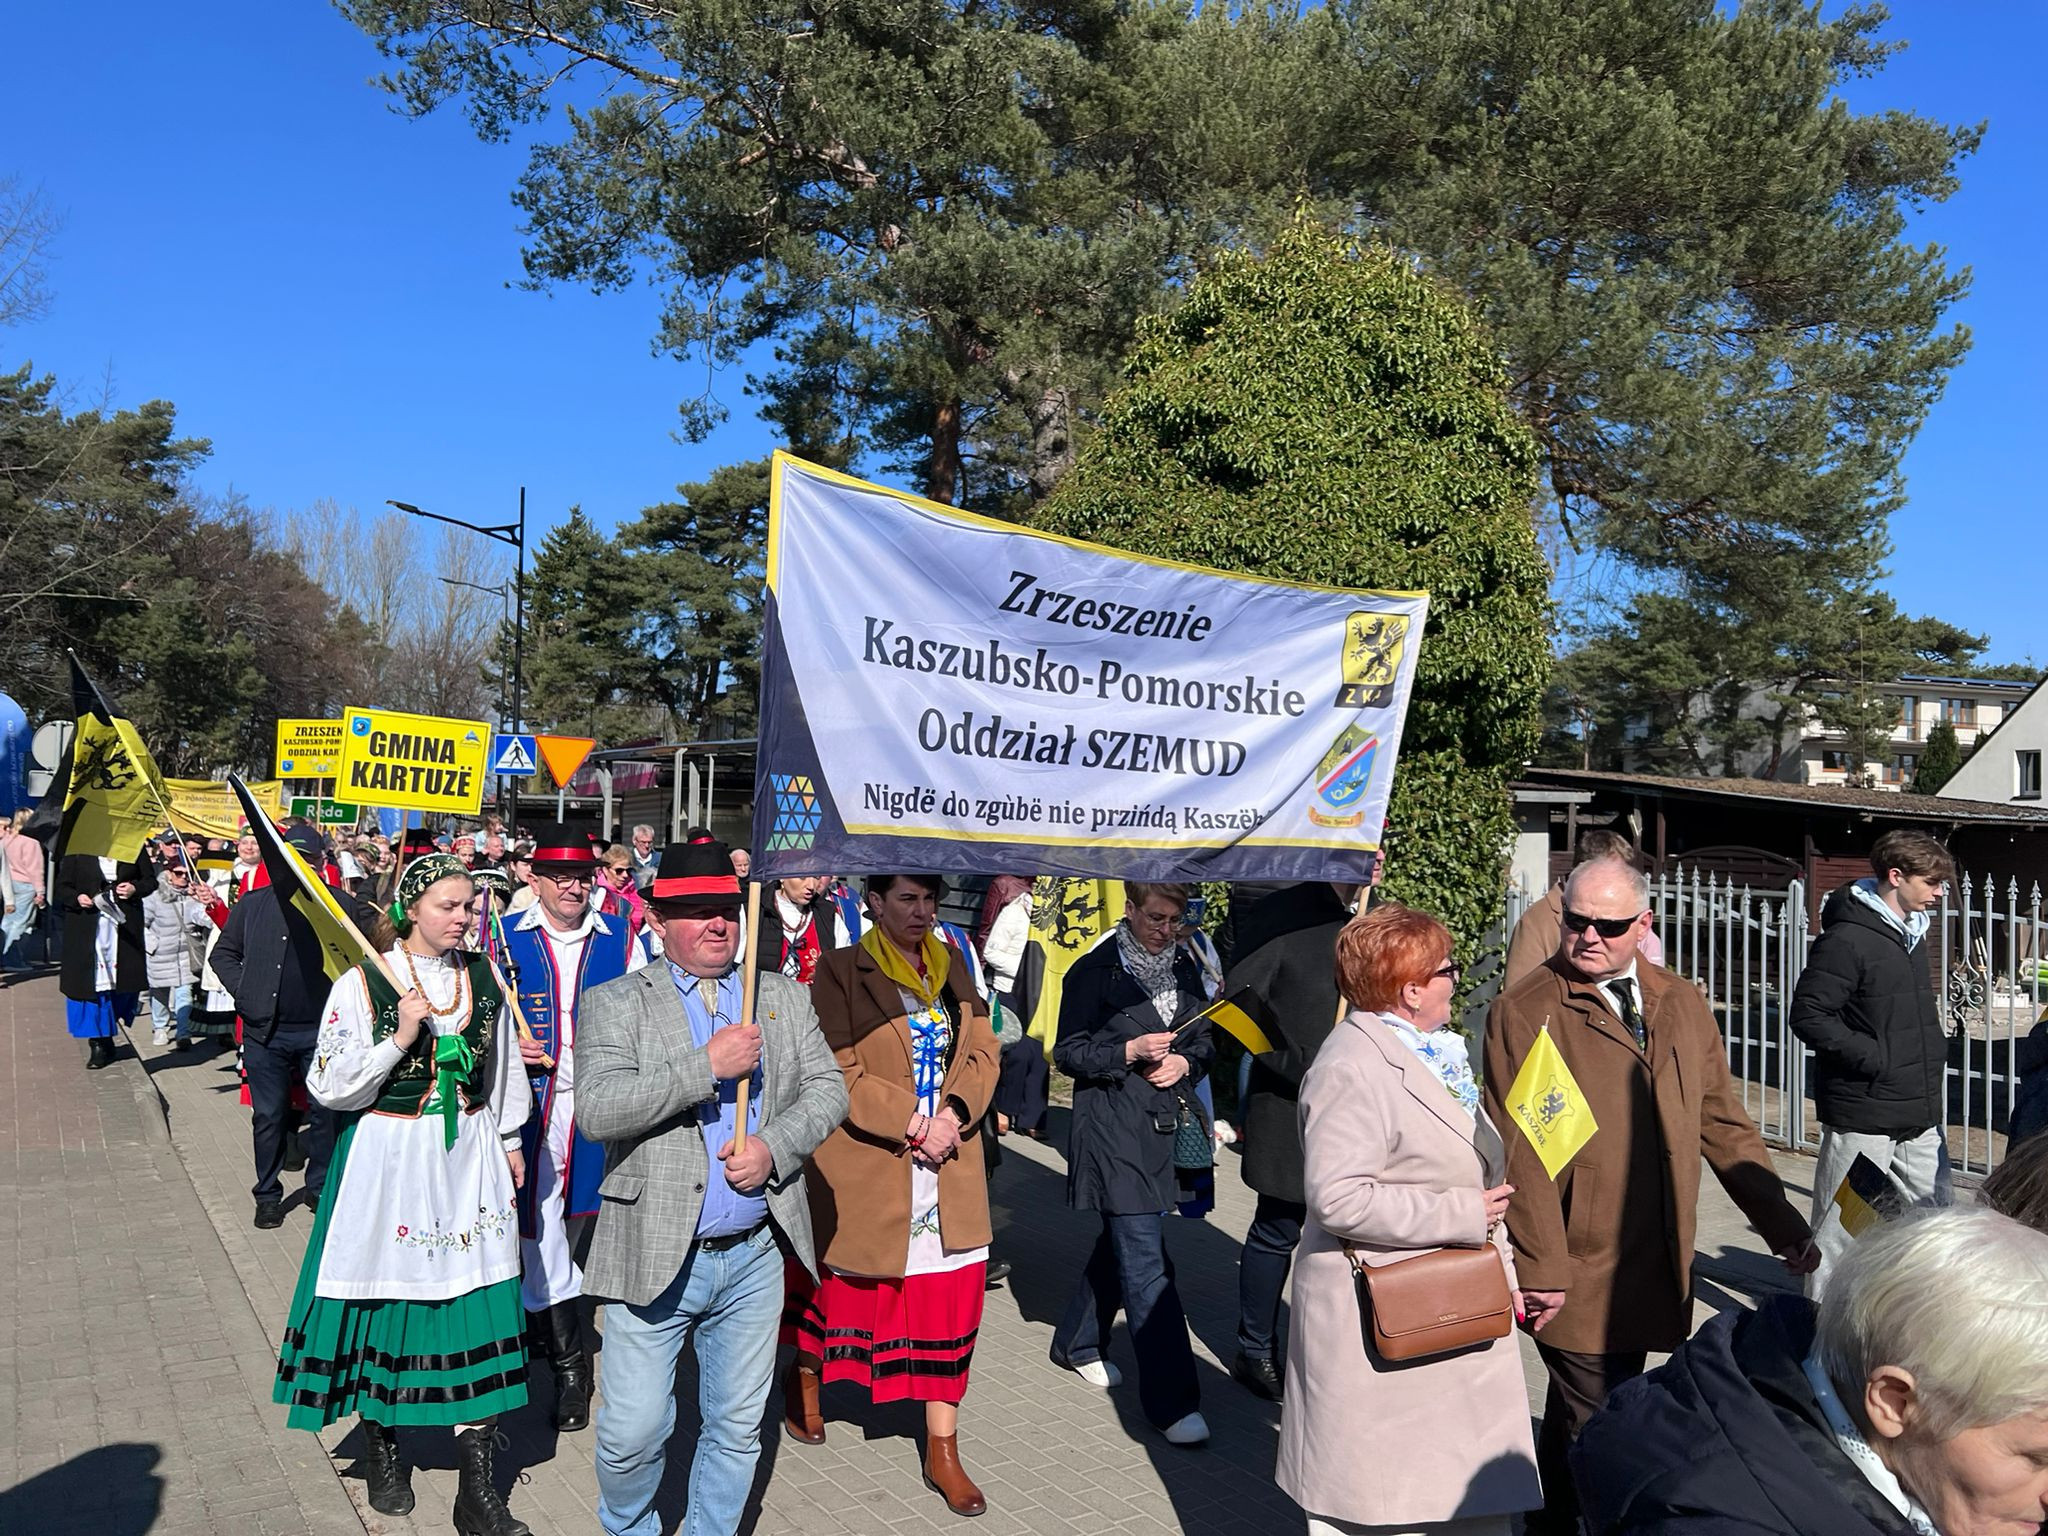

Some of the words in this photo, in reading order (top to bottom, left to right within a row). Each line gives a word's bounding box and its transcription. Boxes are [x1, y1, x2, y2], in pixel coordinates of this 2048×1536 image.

[999, 570, 1212, 642] Zrzeszenie
[863, 615, 1306, 717] Kaszubsko-Pomorskie
[295, 727, 344, 736] ZRZESZEN
[323, 748, 341, 757] KAR
[369, 731, 456, 764] GMINA
[918, 708, 1076, 765] Oddział
[1081, 729, 1247, 777] SZEMUD
[351, 760, 473, 797] KARTUZË
[863, 783, 935, 818] Nigdë
[942, 791, 969, 818] do
[974, 794, 1042, 825] zgùbë
[1048, 801, 1085, 825] nie
[1091, 803, 1177, 835] przińdą
[1184, 807, 1270, 830] Kaszëb
